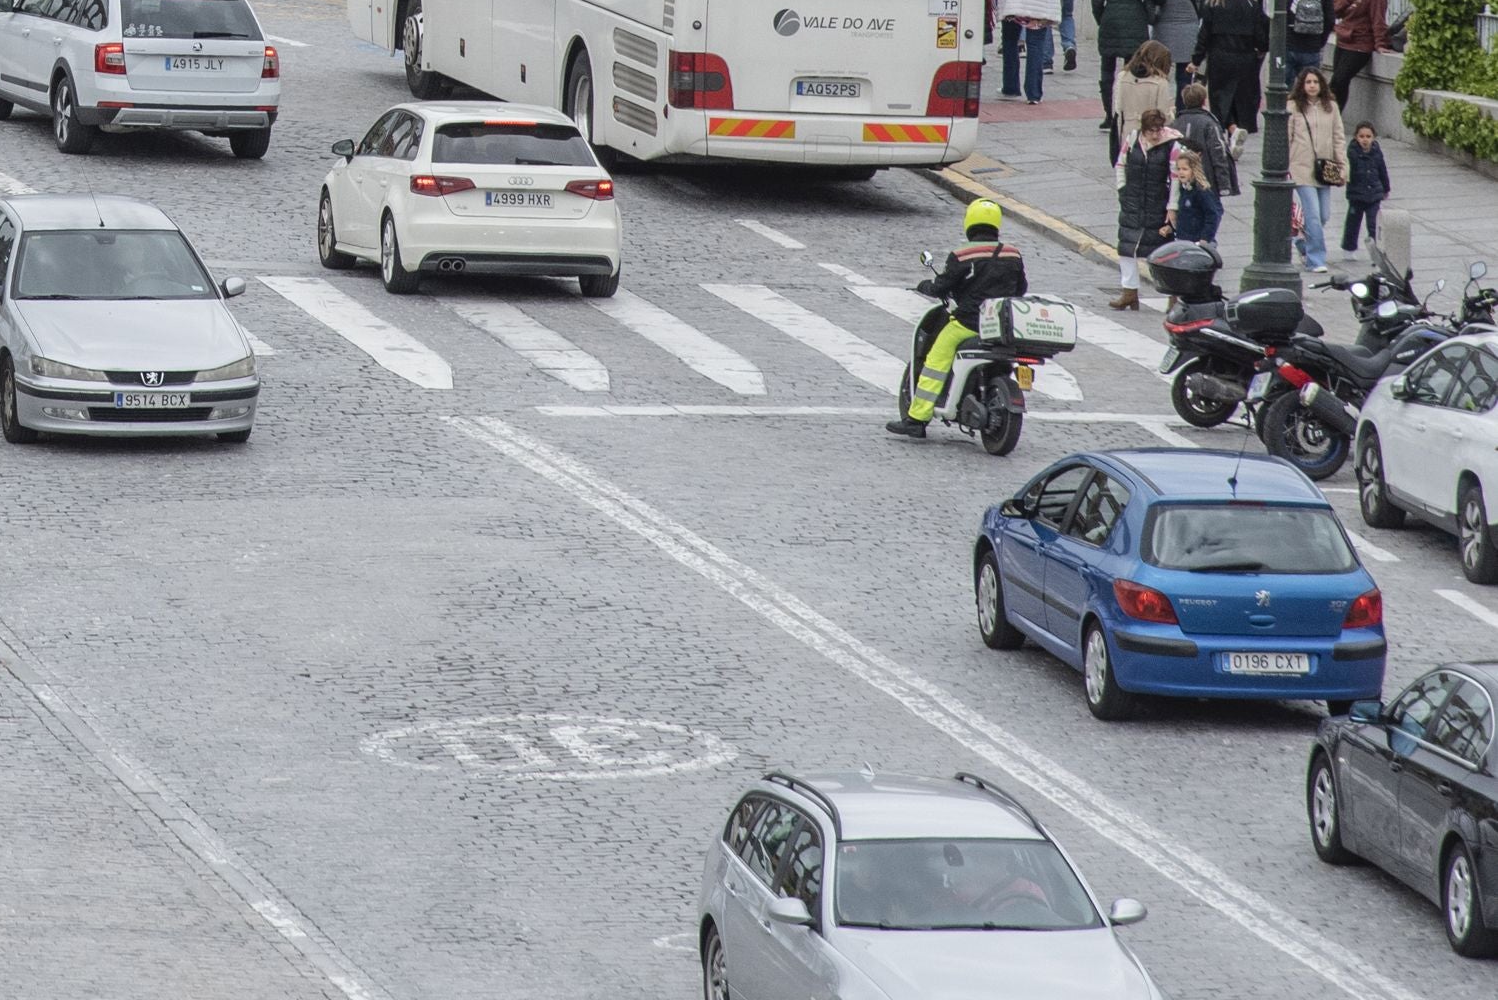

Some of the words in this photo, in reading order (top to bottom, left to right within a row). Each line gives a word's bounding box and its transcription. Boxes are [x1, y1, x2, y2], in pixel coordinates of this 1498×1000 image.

[943, 0, 958, 10] TP
[803, 16, 838, 29] VALE
[842, 18, 863, 29] DO
[866, 18, 896, 31] AVE
[173, 59, 201, 70] 4915
[204, 60, 224, 70] JLY
[493, 193, 524, 205] 4999
[528, 194, 551, 206] HXR
[125, 394, 156, 406] 9514
[162, 394, 186, 406] BCX
[1233, 655, 1269, 669] 0196
[1275, 655, 1302, 669] CXT
